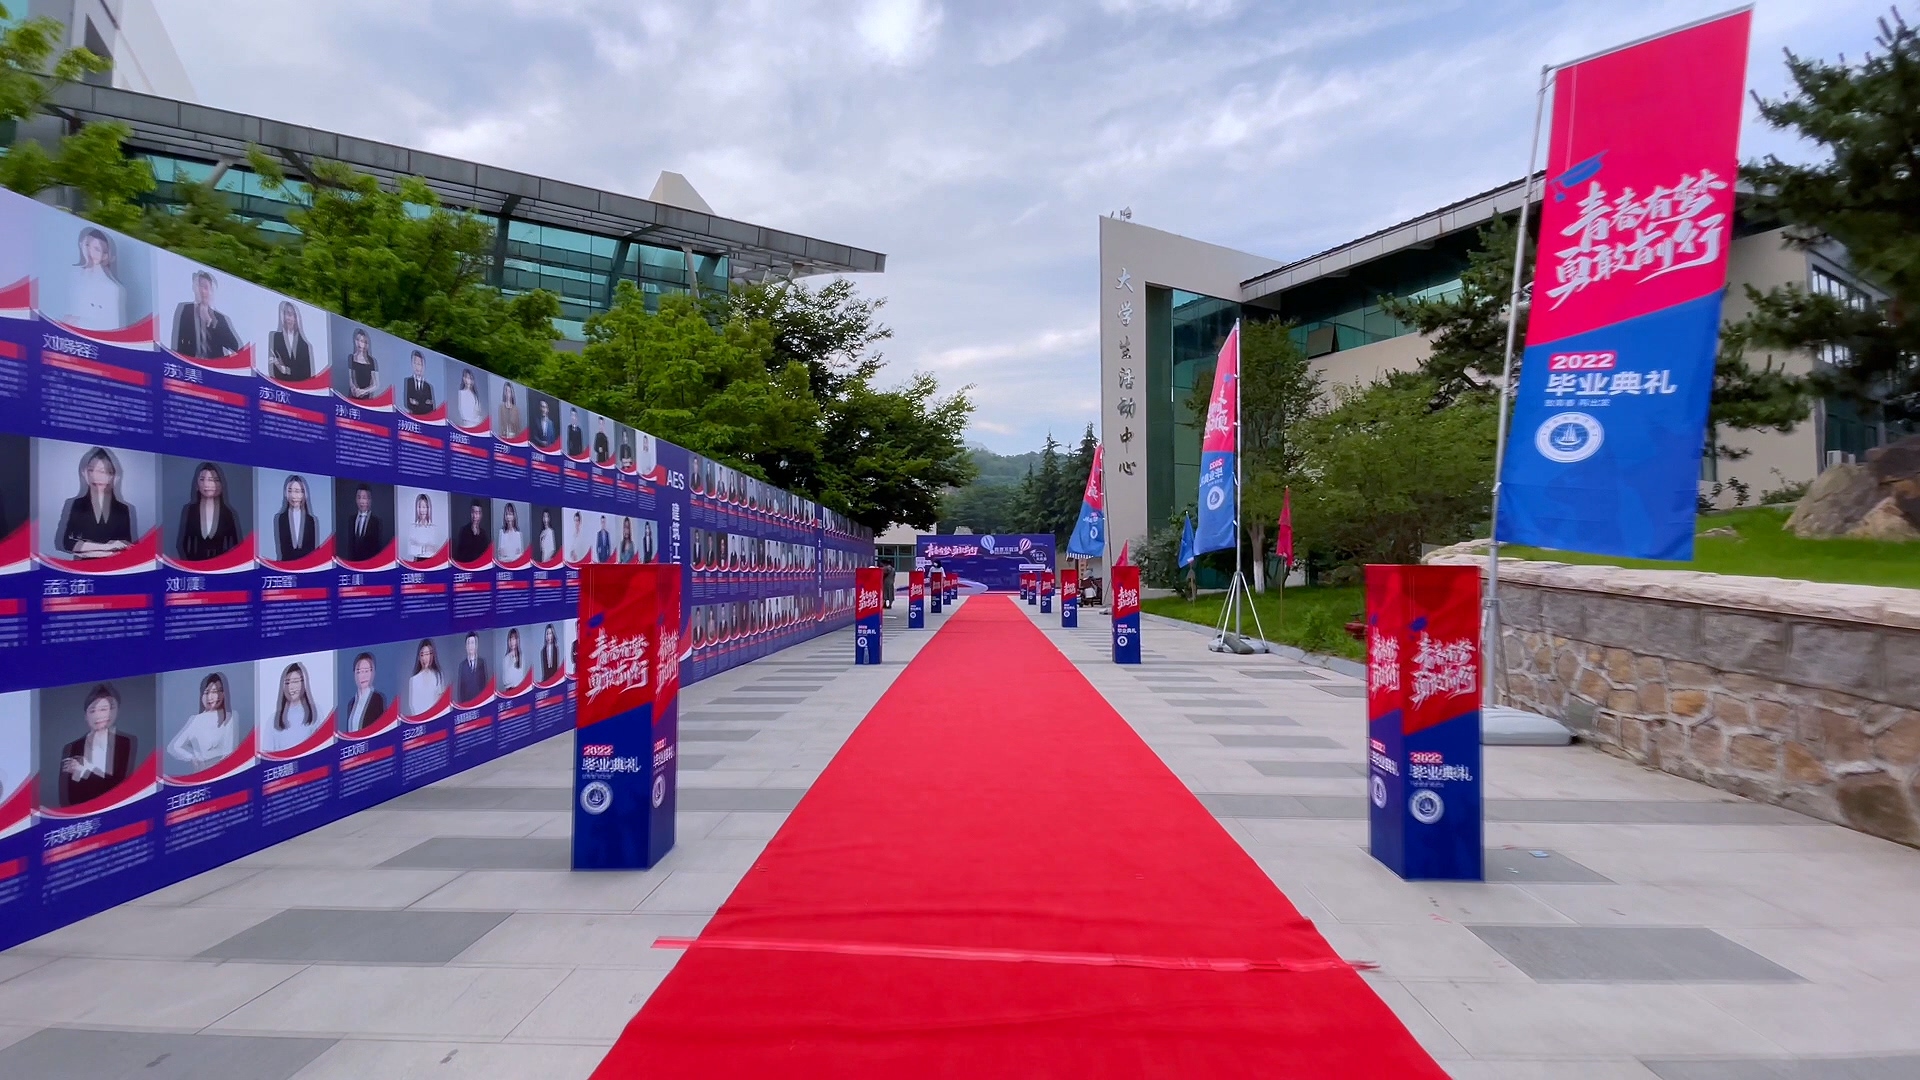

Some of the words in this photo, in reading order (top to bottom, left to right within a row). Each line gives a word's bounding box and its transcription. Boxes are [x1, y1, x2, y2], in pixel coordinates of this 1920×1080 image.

[1560, 168, 1728, 249] 青春有梦
[1545, 213, 1726, 311] 勇敢前行
[1551, 353, 1615, 370] 2022
[1114, 267, 1136, 476] 大学生活动中心
[1544, 369, 1678, 396] 毕业典礼
[666, 469, 685, 491] AES
[583, 745, 614, 756] 2022
[1410, 752, 1443, 764] 2022
[581, 756, 642, 773] 毕业典礼
[1409, 764, 1473, 781] 毕业典礼
